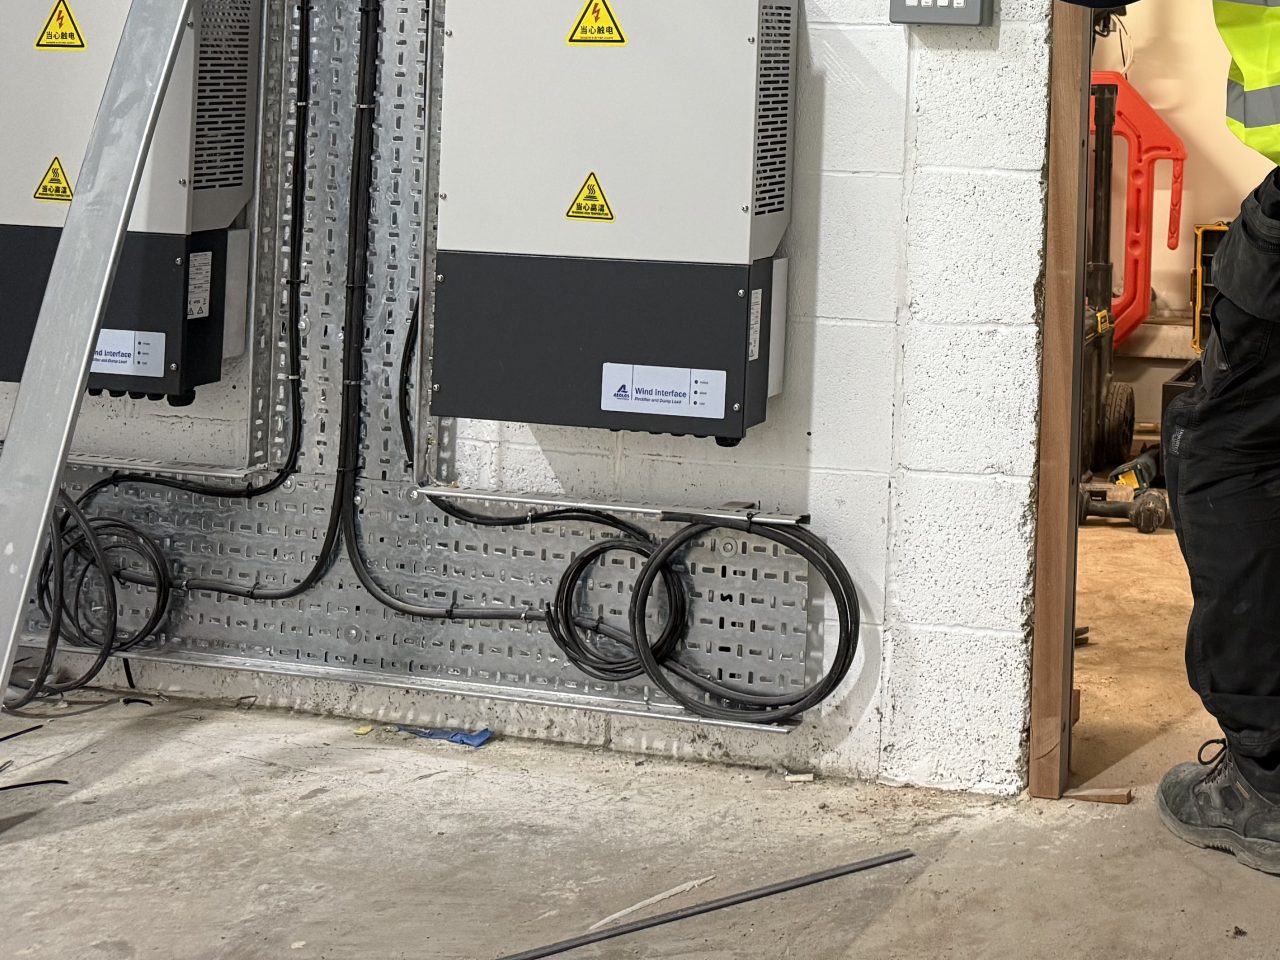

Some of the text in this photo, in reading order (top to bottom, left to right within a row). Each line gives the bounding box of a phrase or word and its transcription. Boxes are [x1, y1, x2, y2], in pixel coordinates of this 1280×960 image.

[580, 25, 614, 35] 当心触电
[46, 31, 76, 40] 当心触电
[104, 349, 132, 358] Interface
[634, 387, 687, 399] Wind Interface
